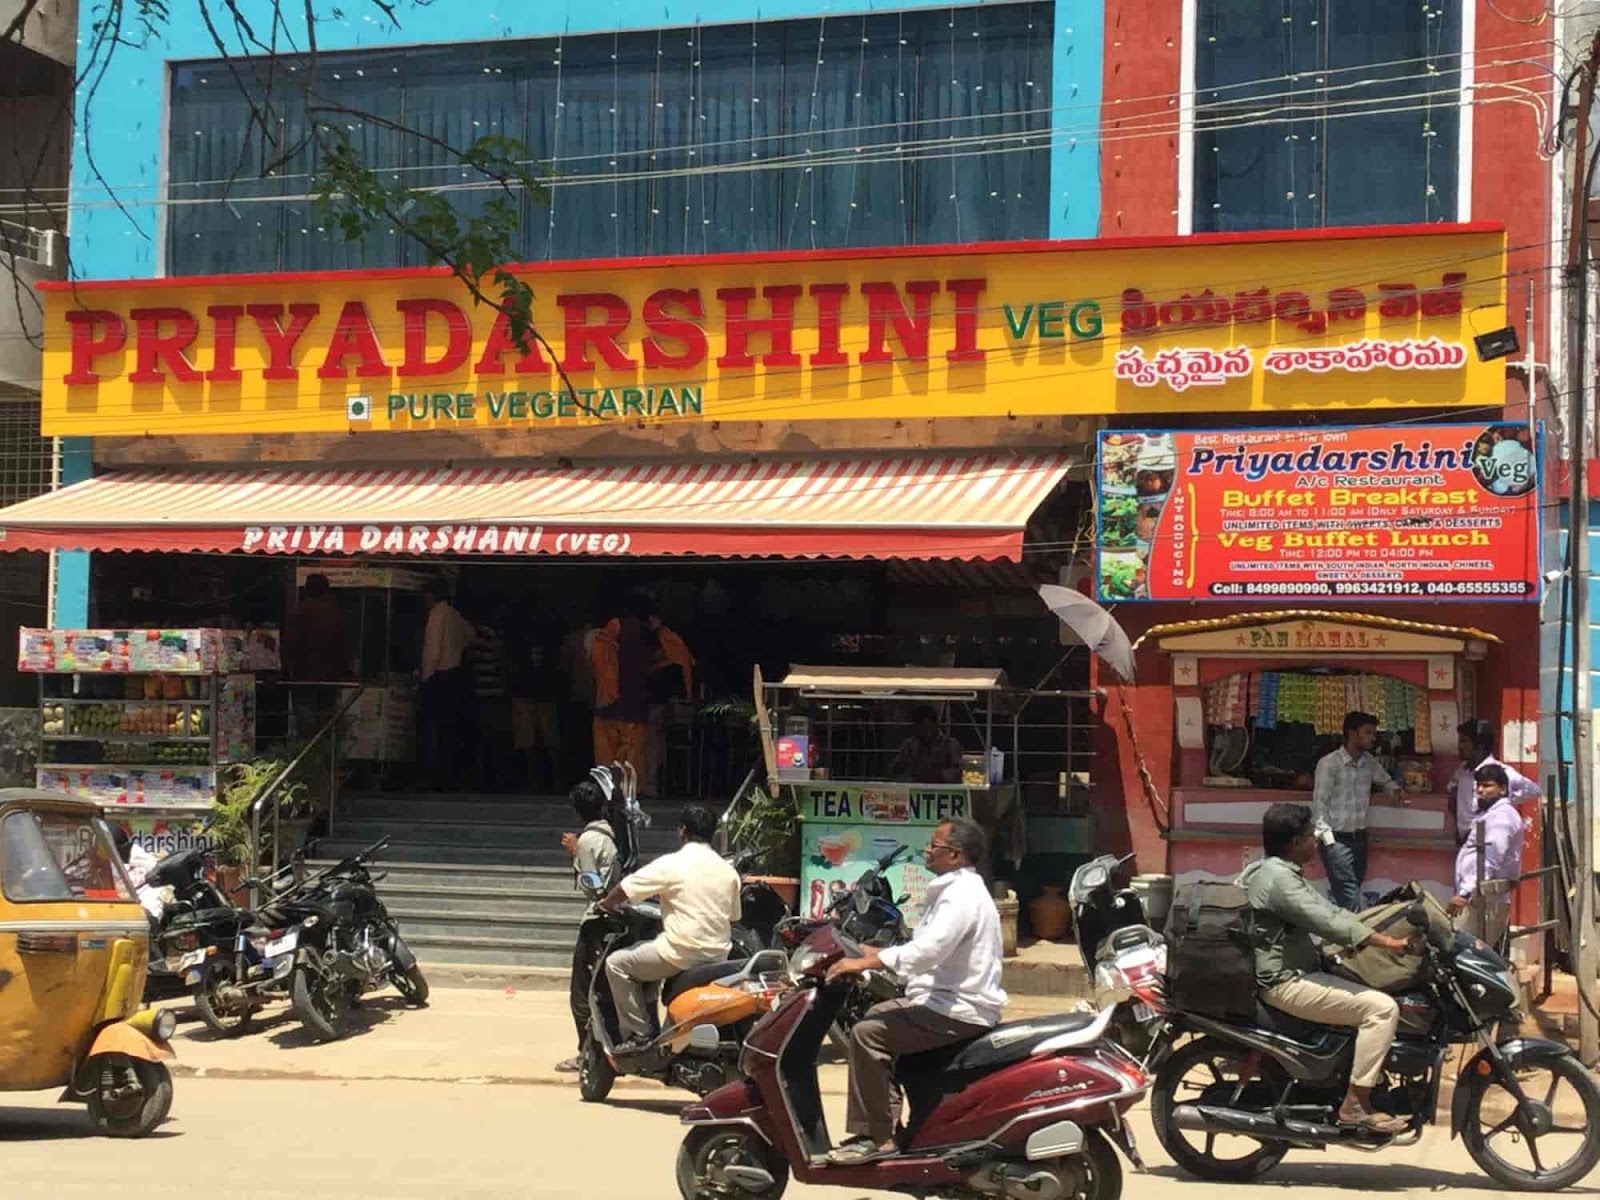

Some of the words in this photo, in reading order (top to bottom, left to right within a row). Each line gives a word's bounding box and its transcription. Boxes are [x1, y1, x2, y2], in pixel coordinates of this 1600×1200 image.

[63, 278, 988, 385] PRIYADARSHINI
[1002, 300, 1103, 340] VEG
[387, 393, 475, 420] PURE
[486, 387, 703, 419] VEGETARIAN
[1222, 433, 1281, 444] Restaurant
[1188, 441, 1474, 481] Priyadarshini
[1480, 458, 1529, 483] Veg
[1297, 476, 1328, 487] A/c
[1335, 473, 1445, 487] Restaurant
[1223, 490, 1315, 507] Buffet
[1330, 487, 1478, 506] Breakfast
[1224, 521, 1280, 530] UNLIMITED
[1282, 520, 1314, 530] ITEMS
[1445, 518, 1501, 528] DESSERTS
[243, 526, 344, 551] PRIYA
[360, 525, 543, 551] DARSHANI
[555, 532, 631, 553] (VEG)
[1217, 532, 1273, 551] Veg
[1283, 531, 1379, 548] Buffet
[1391, 530, 1490, 546] Lunch
[1213, 583, 1243, 594] Cell:
[810, 790, 851, 817] TEA
